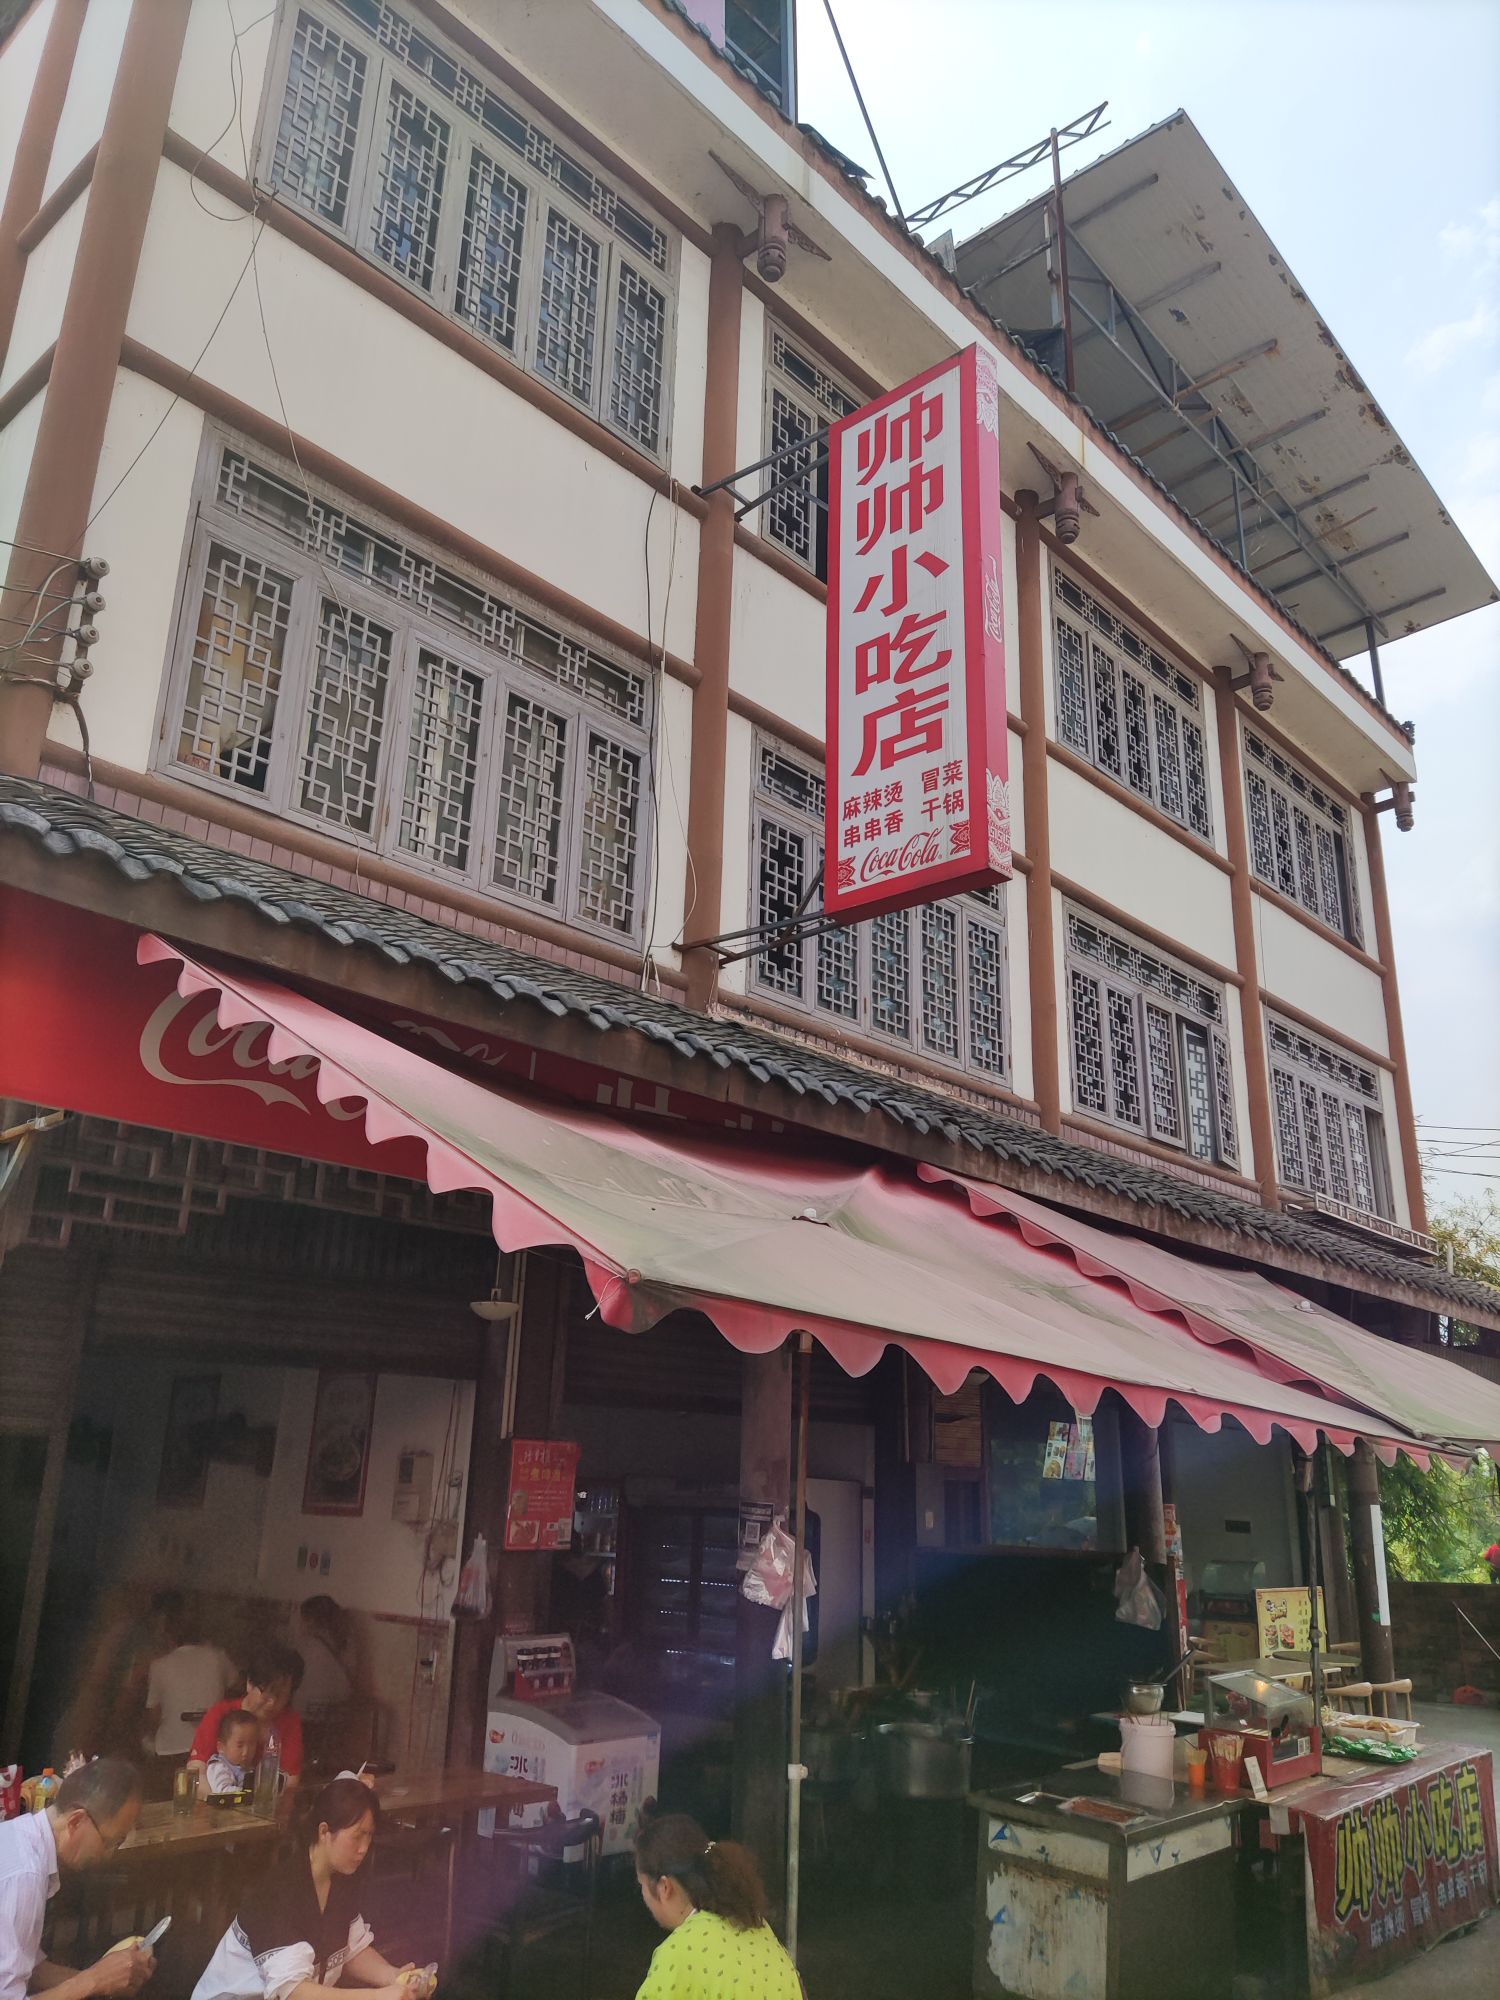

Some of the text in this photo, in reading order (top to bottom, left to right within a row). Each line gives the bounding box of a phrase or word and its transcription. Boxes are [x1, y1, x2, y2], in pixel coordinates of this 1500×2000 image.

[852, 391, 952, 777] 帅帅小吃店
[843, 759, 963, 821] 麻辣烫 冒菜
[843, 789, 964, 848] 串串香 干锅
[1336, 1760, 1485, 1922] 帅帅小吃店
